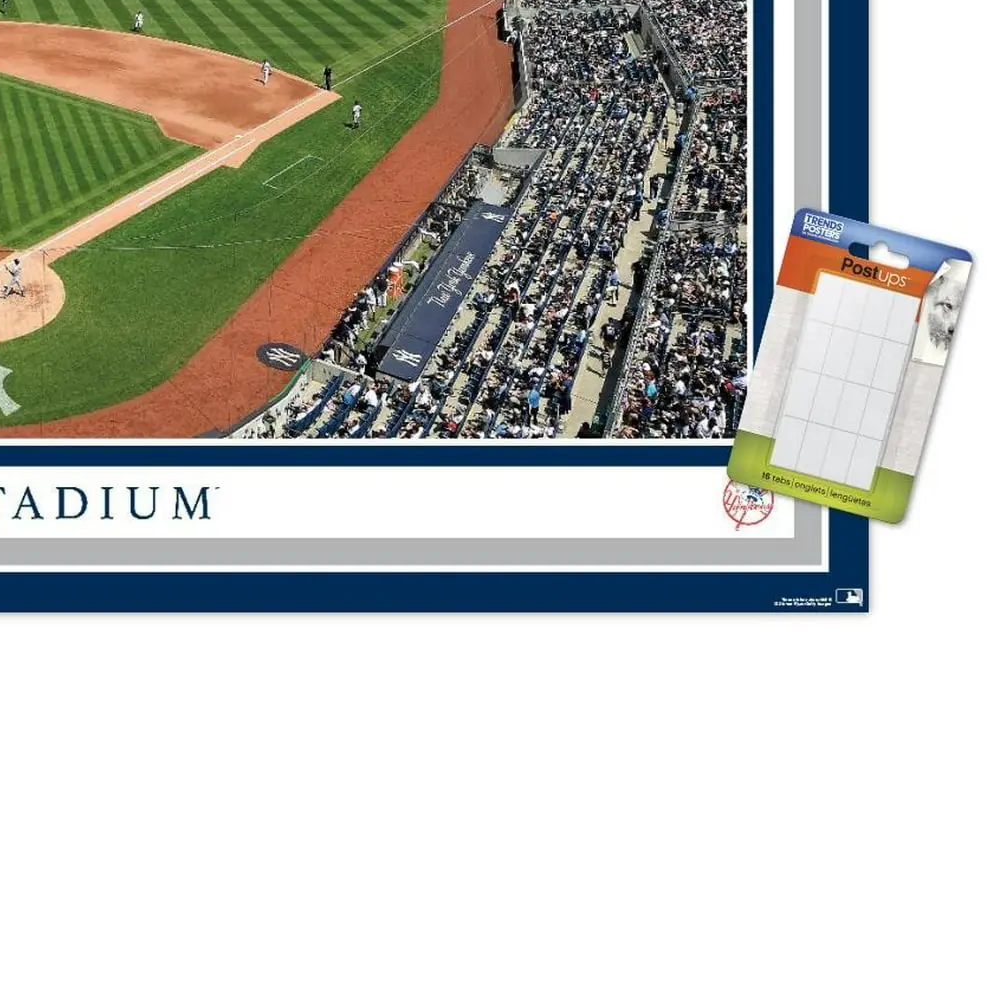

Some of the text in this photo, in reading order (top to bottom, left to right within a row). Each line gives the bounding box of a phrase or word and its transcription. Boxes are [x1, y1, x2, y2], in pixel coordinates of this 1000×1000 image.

[805, 214, 843, 231] TRENDS
[803, 223, 841, 240] POSTERS
[841, 257, 908, 288] Postups
[761, 471, 771, 481] 16
